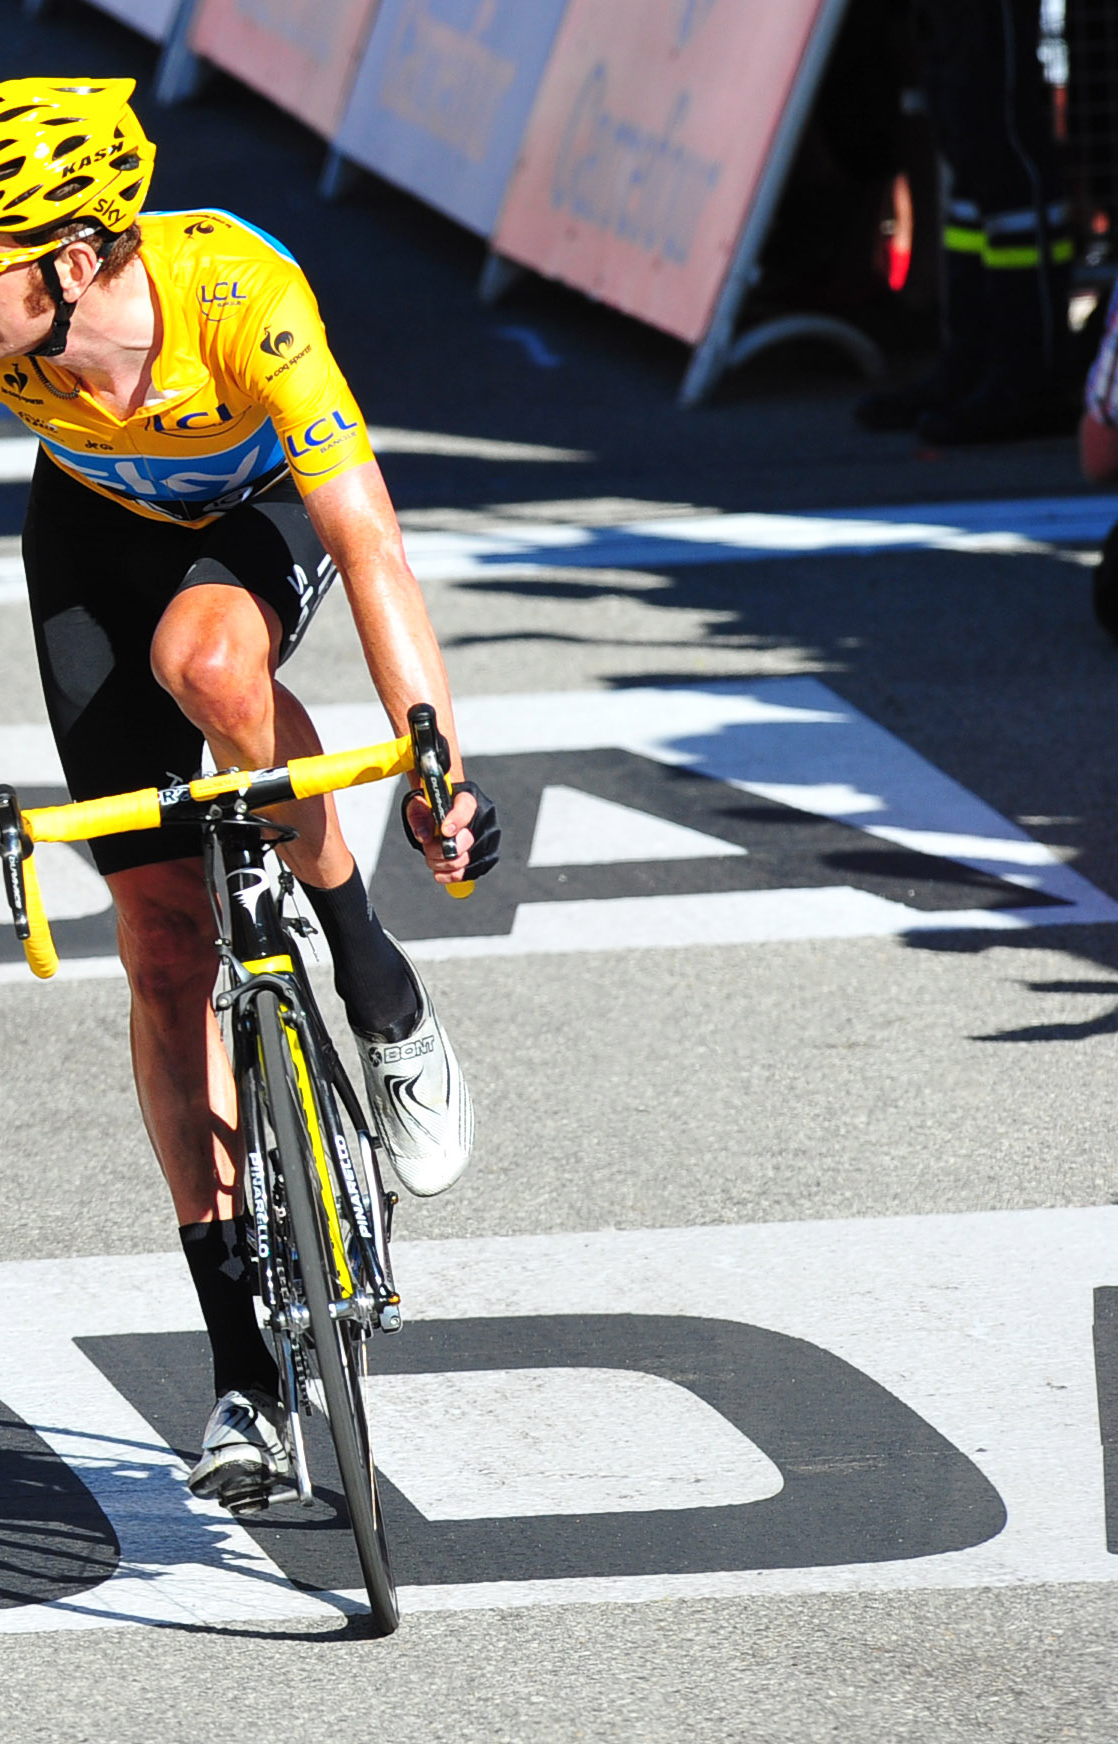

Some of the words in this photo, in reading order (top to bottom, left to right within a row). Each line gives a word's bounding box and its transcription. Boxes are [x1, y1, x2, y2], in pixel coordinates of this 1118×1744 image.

[62, 141, 124, 178] KASK
[201, 281, 247, 303] LCL
[286, 410, 358, 458] LCL
[383, 1034, 435, 1065] BONT
[334, 1134, 373, 1239] PINARELLO
